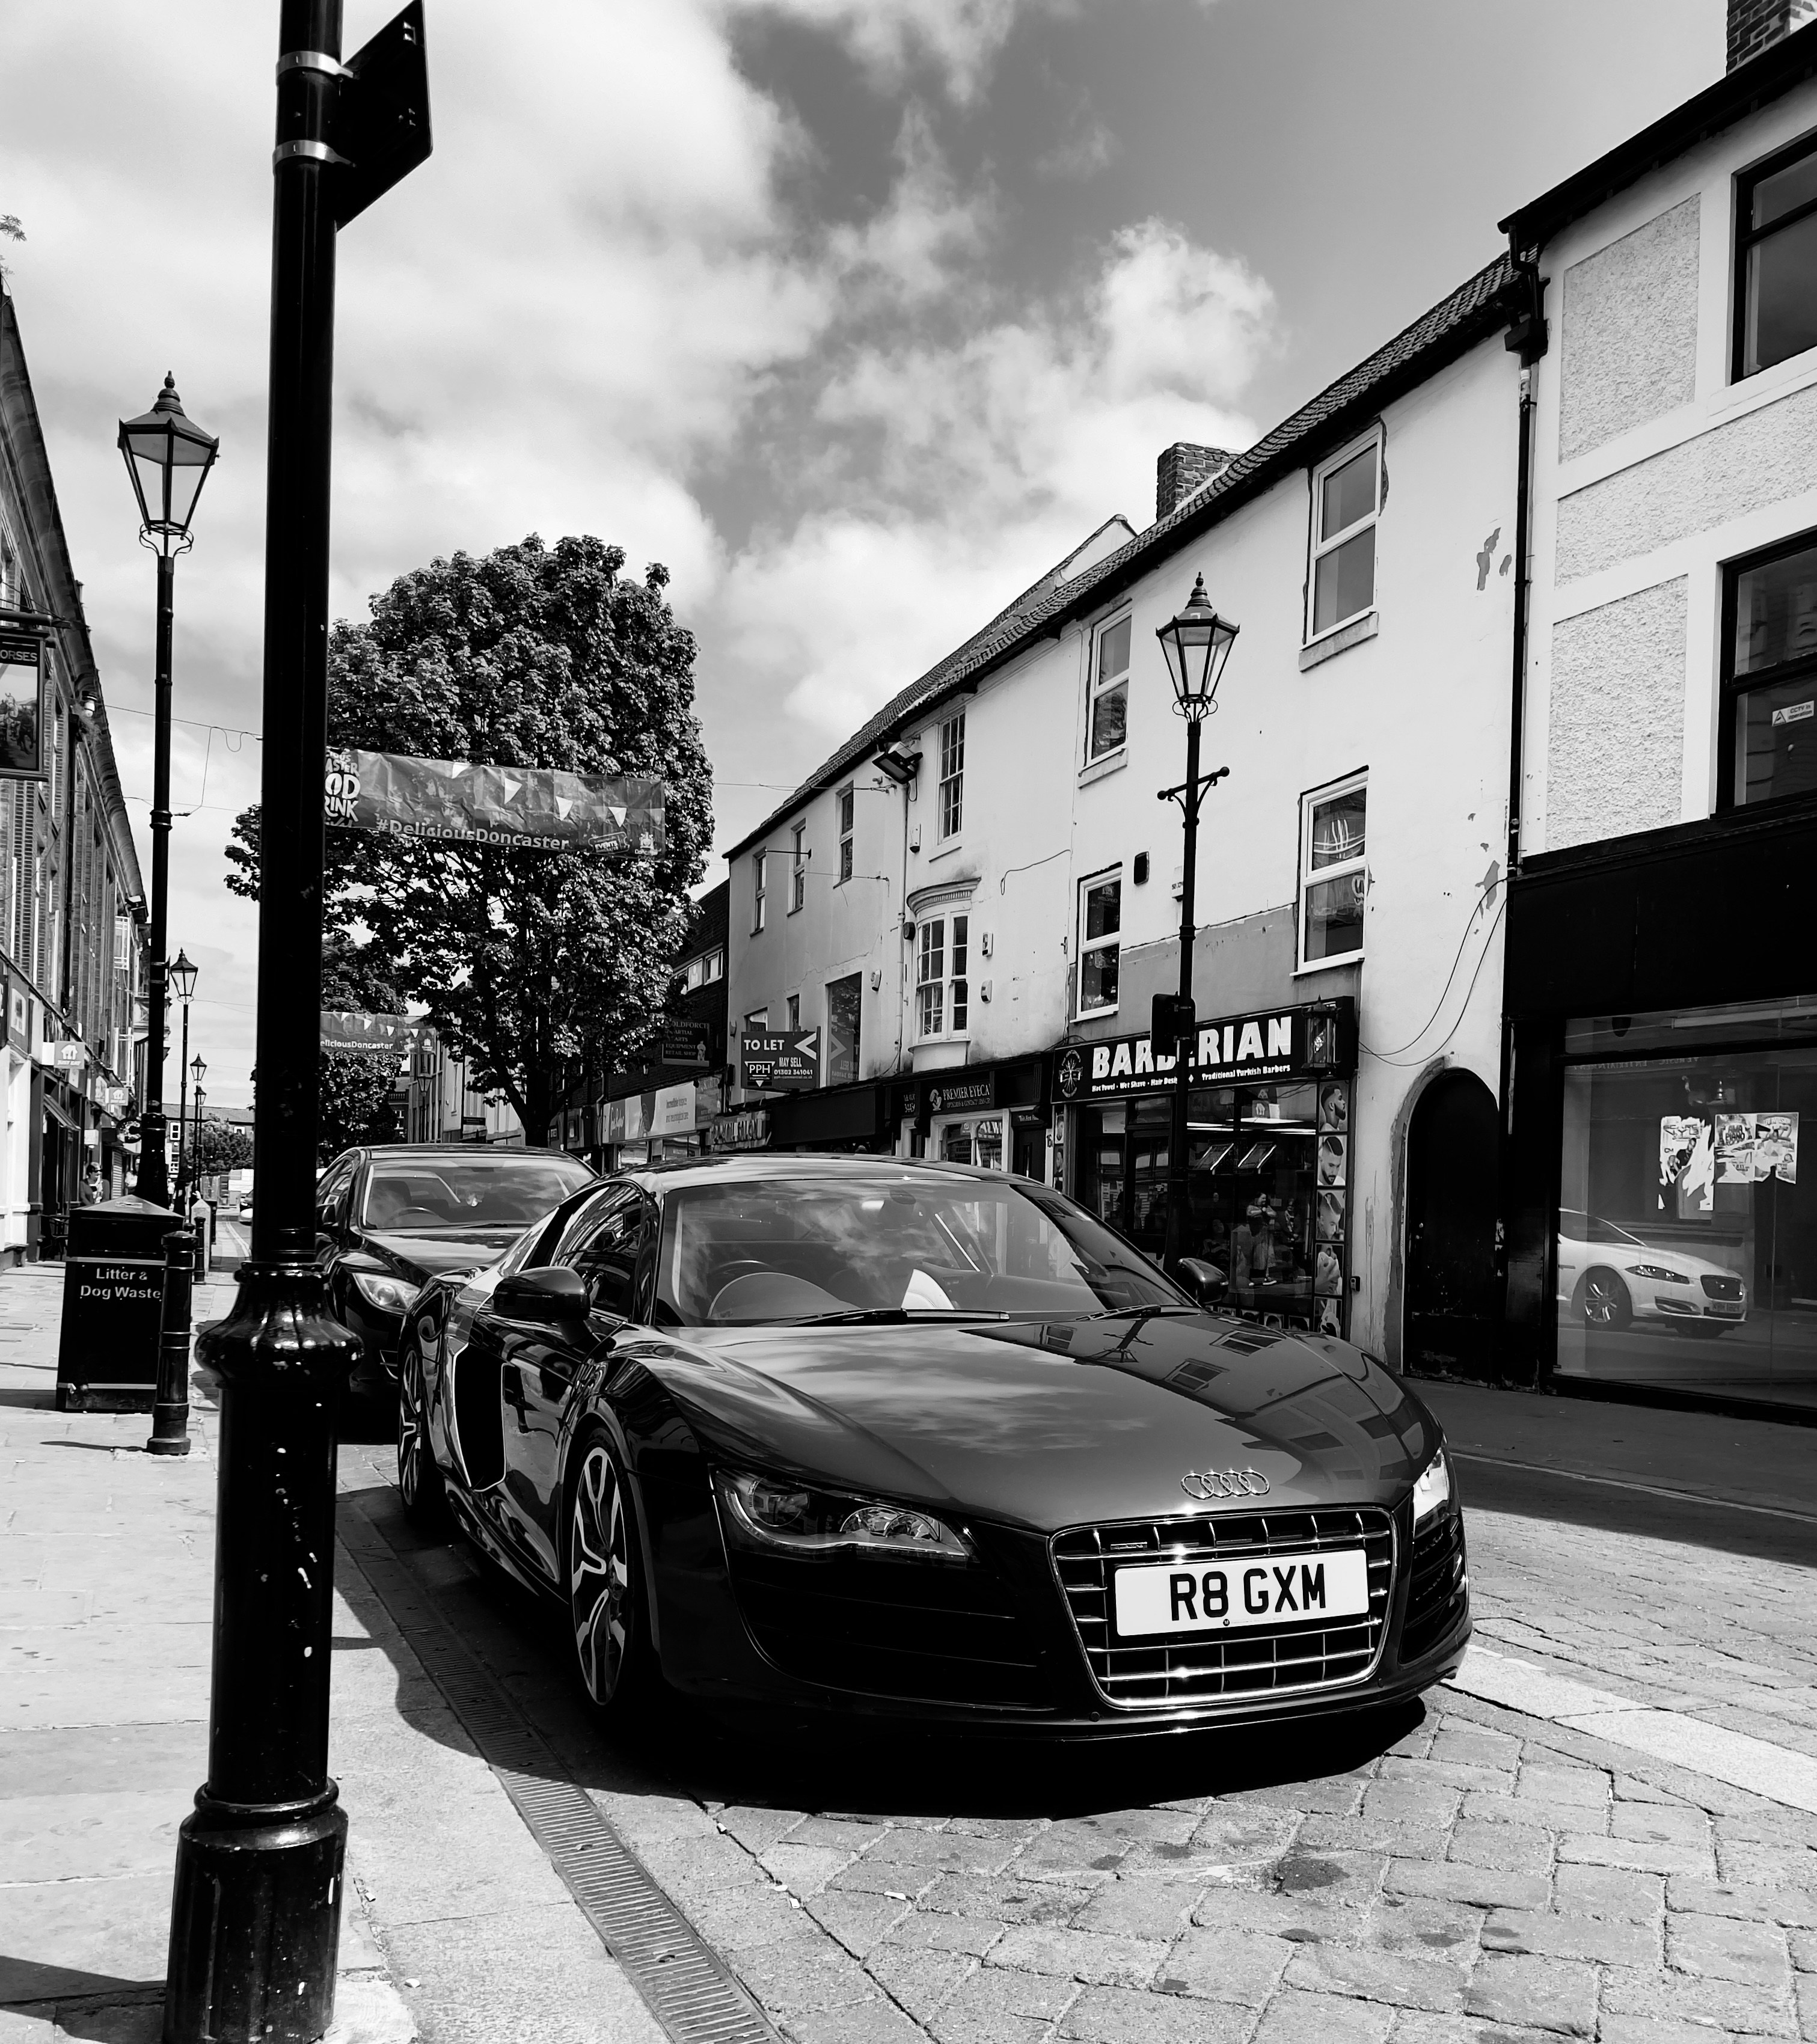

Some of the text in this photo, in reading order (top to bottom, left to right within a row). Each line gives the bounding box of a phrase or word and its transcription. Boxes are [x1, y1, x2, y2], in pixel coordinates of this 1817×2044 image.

[376, 819, 570, 850] #DeliciousDoncaster
[744, 1039, 785, 1051] TO LET
[749, 1064, 770, 1074] PPH
[779, 1057, 802, 1068] MAY SELL
[1202, 1065, 1290, 1081] Traditional Turkish Barbers
[942, 1086, 969, 1100] PREMIER
[96, 1268, 147, 1281] Litter &
[81, 1285, 161, 1300] Dog Waste
[1169, 1563, 1326, 1621] R8 GXM
